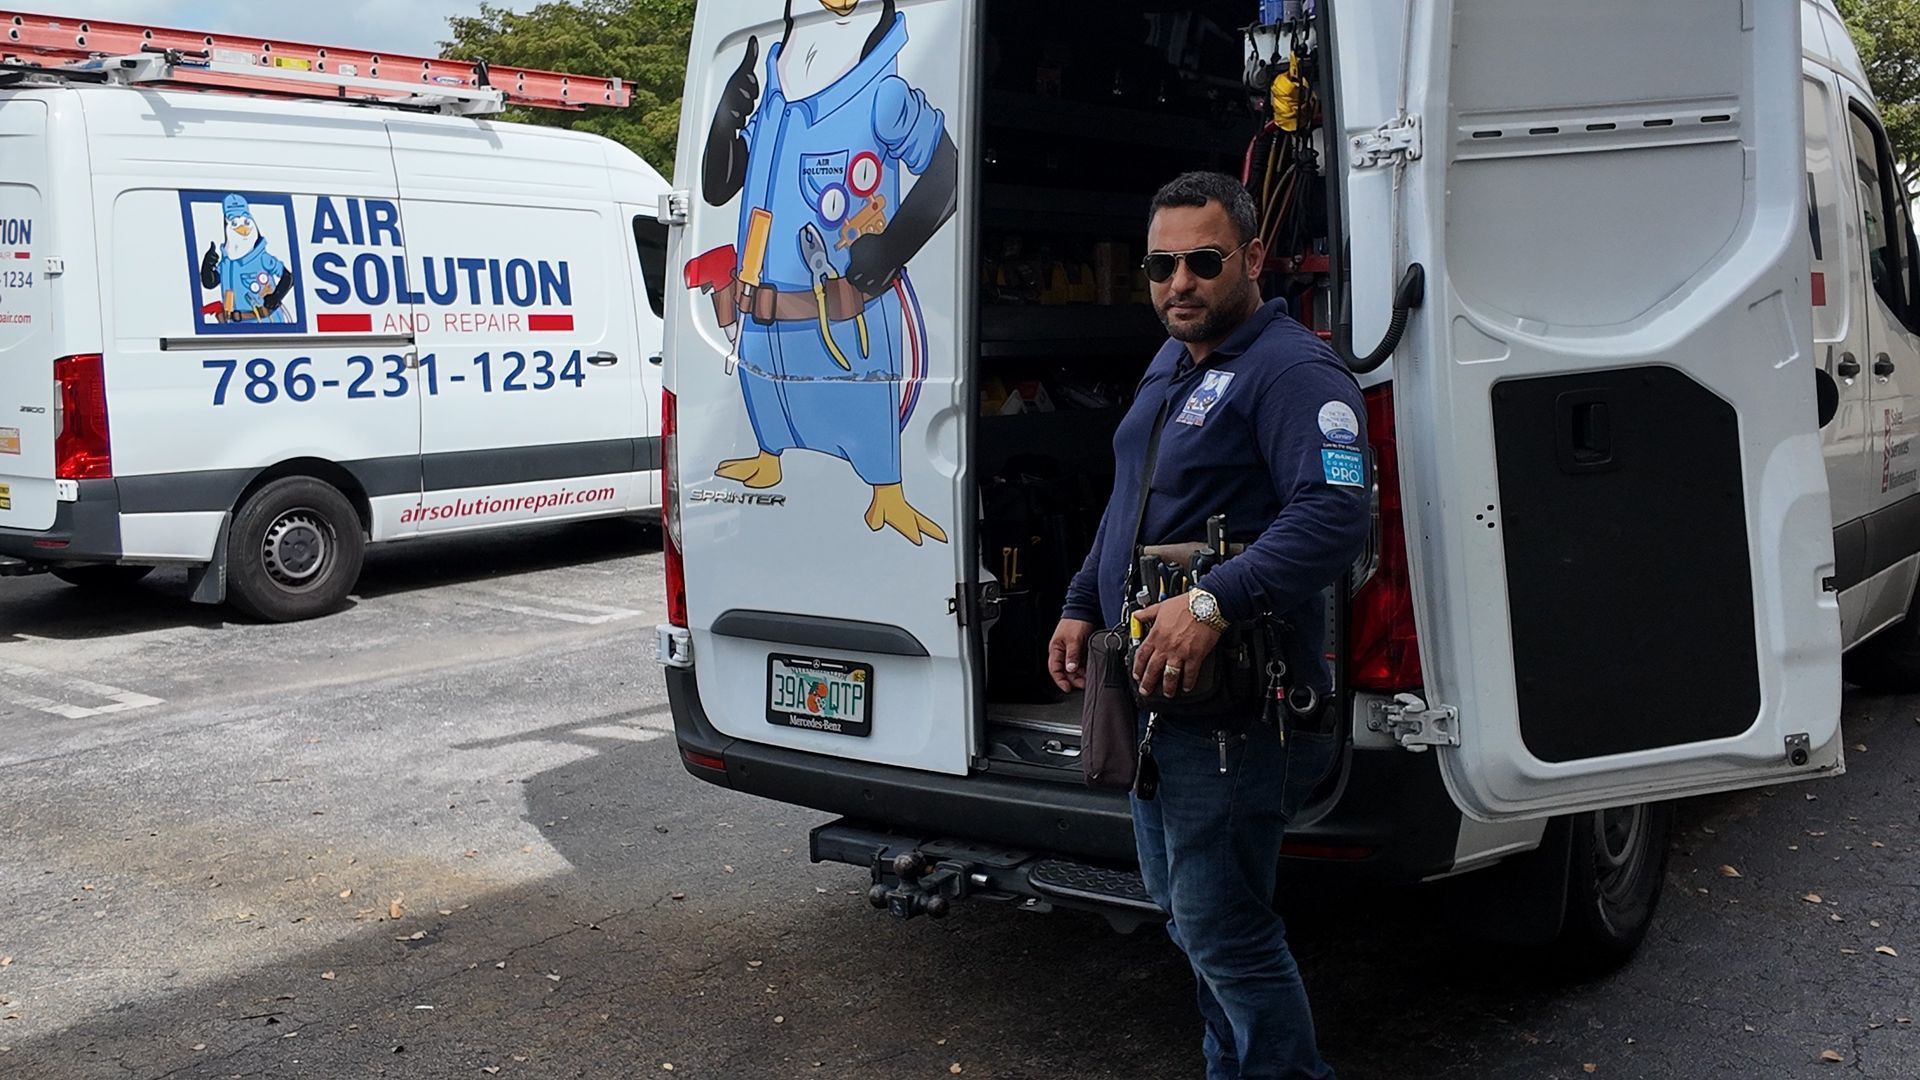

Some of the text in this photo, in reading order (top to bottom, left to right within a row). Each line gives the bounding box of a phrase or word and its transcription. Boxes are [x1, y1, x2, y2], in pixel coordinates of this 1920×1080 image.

[803, 167, 843, 175] SOLUTIONS
[0, 219, 32, 245] ION
[311, 195, 403, 247] AIR
[312, 252, 572, 307] SOLUTION
[384, 313, 521, 332] AND REPAIR
[202, 350, 586, 406] 786-231-1234
[1331, 466, 1360, 483] PRO
[400, 487, 615, 523] airsolutionrepair.com
[690, 488, 786, 507] SPRINTER
[774, 673, 863, 716] 39A QTP
[789, 714, 841, 732] Mercedes-Benz
